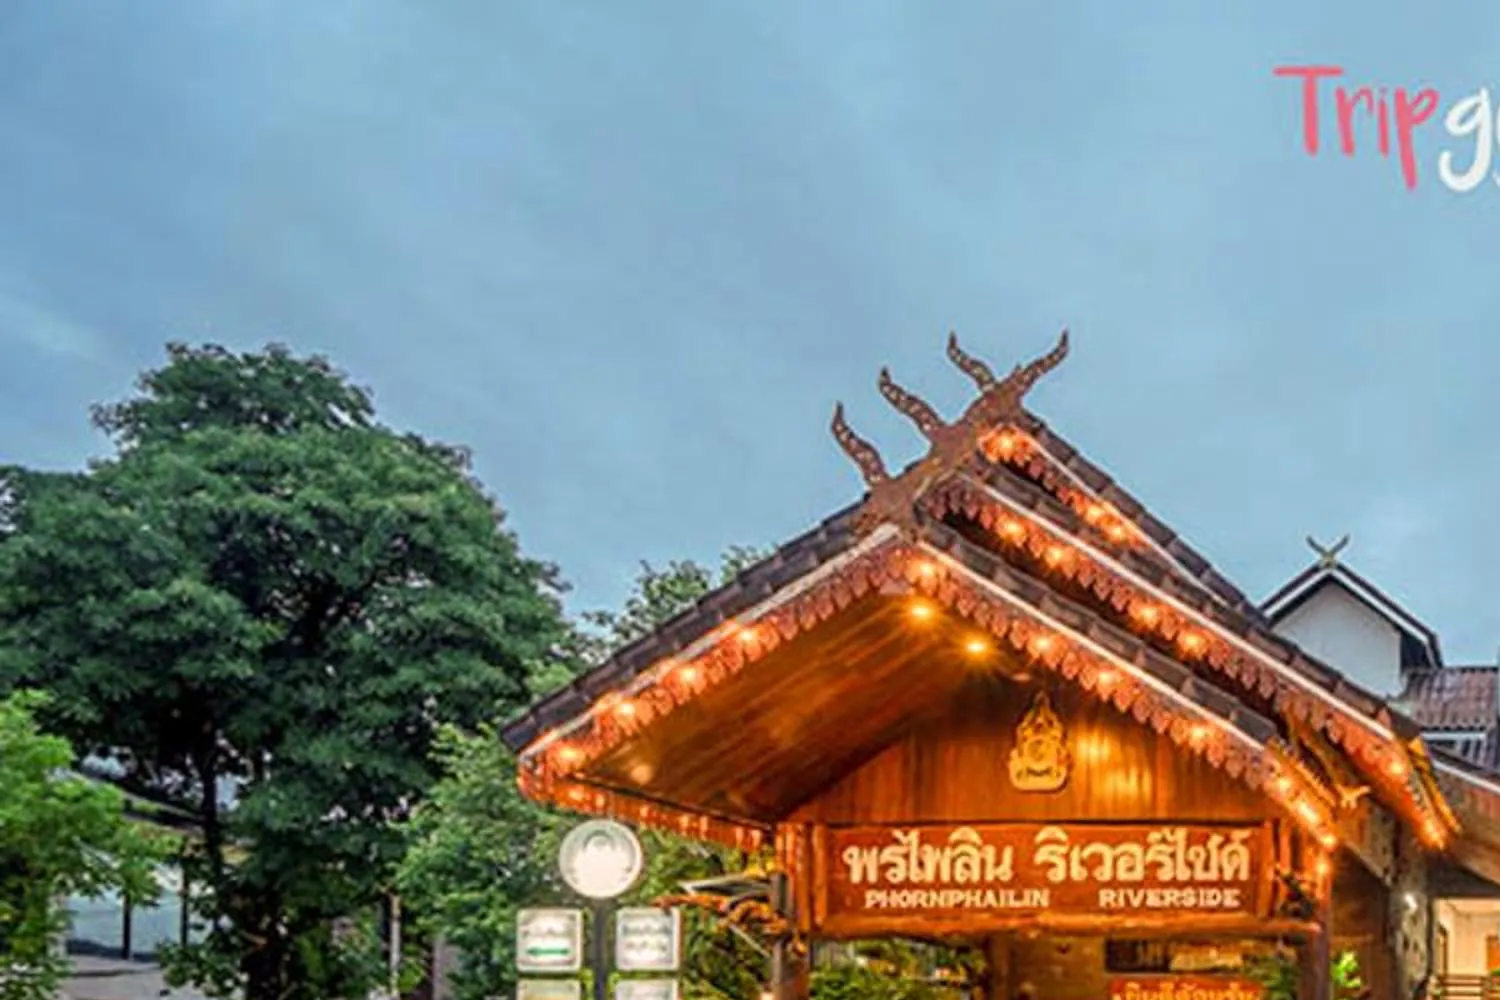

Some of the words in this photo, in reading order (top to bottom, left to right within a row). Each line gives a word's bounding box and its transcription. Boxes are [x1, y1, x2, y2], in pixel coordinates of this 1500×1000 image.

[842, 827, 1013, 883] พรไพลิน
[864, 888, 1050, 909] PHORNPHAILIN
[1099, 888, 1241, 908] RIVERSIDE
